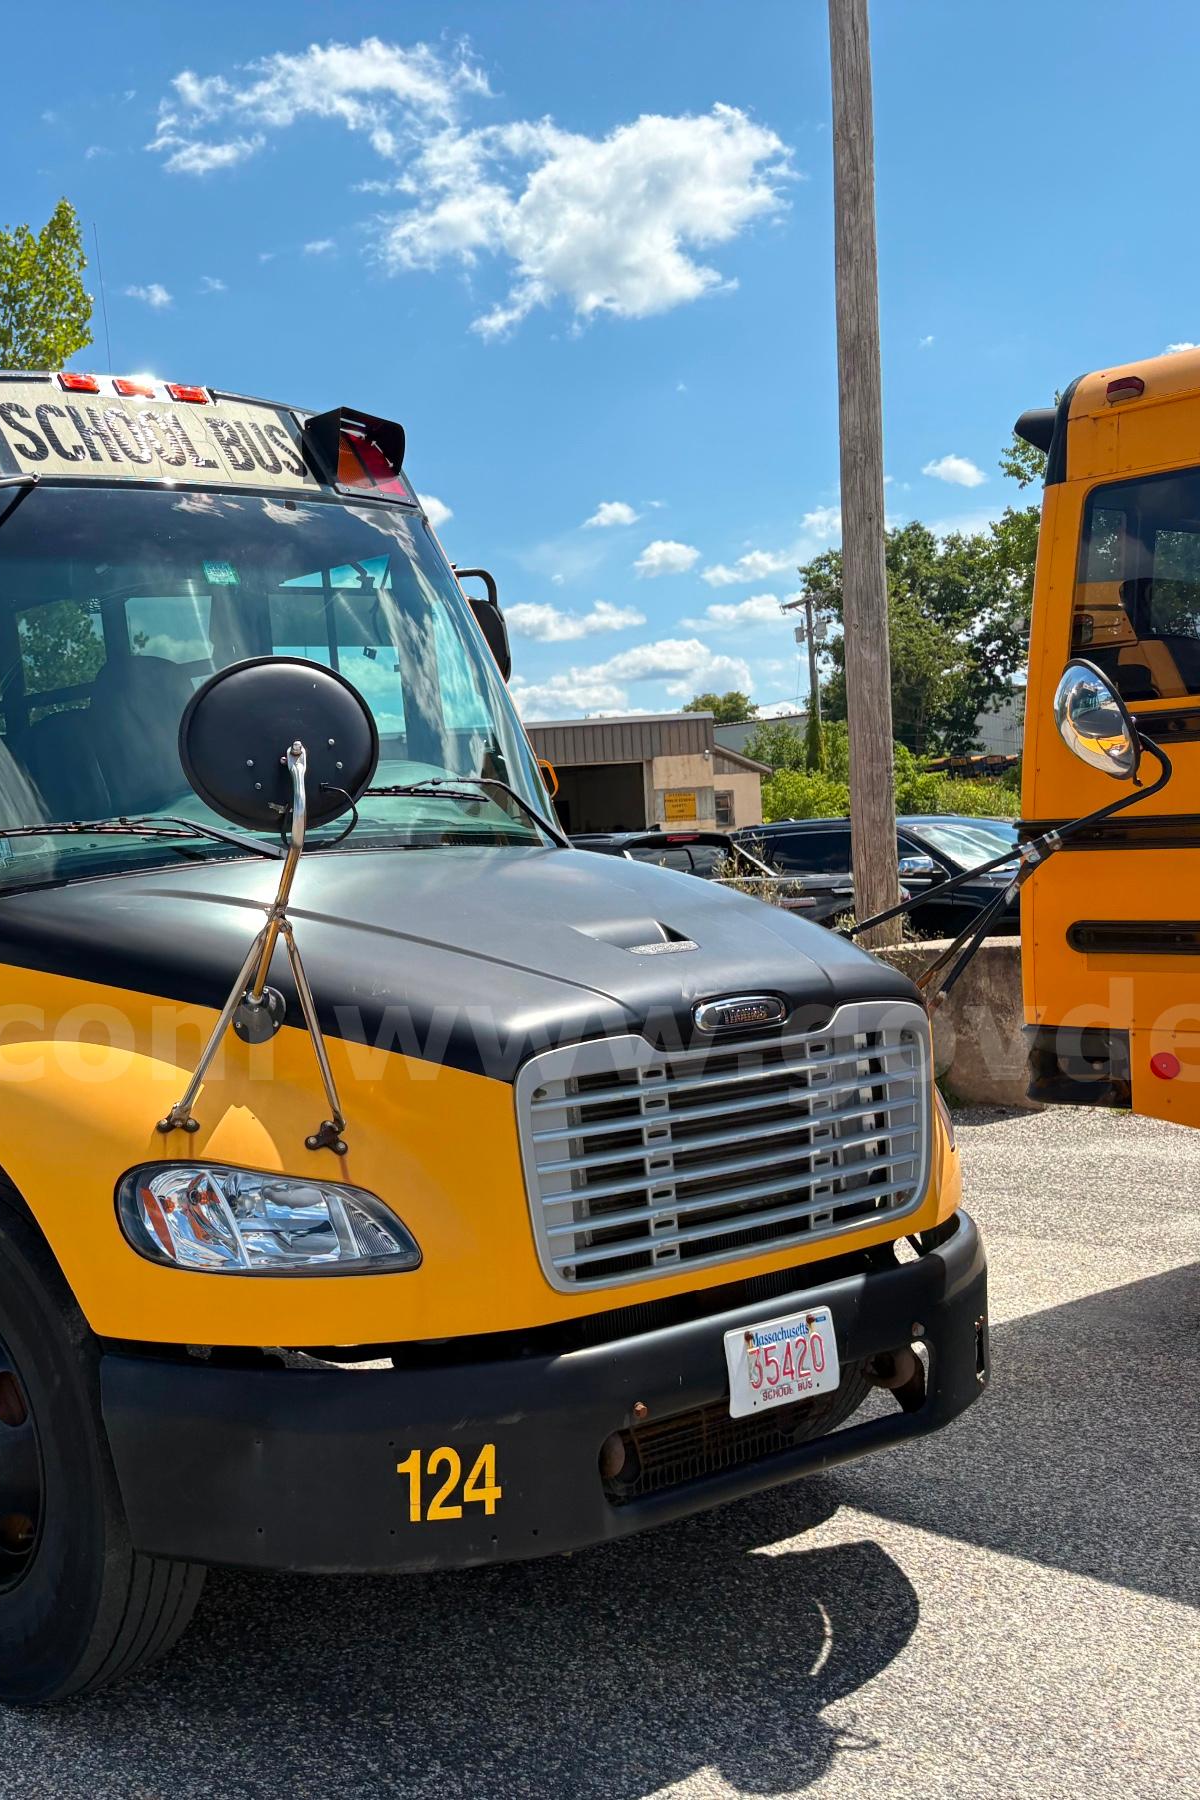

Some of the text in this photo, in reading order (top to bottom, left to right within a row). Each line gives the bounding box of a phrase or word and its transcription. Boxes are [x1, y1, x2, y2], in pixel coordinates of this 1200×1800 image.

[208, 417, 308, 478] BUS
[749, 1333, 826, 1390] 35420
[750, 1323, 810, 1349] Massachusetts
[762, 1378, 814, 1402] SCHOOL BUS
[397, 1443, 502, 1522] 124
